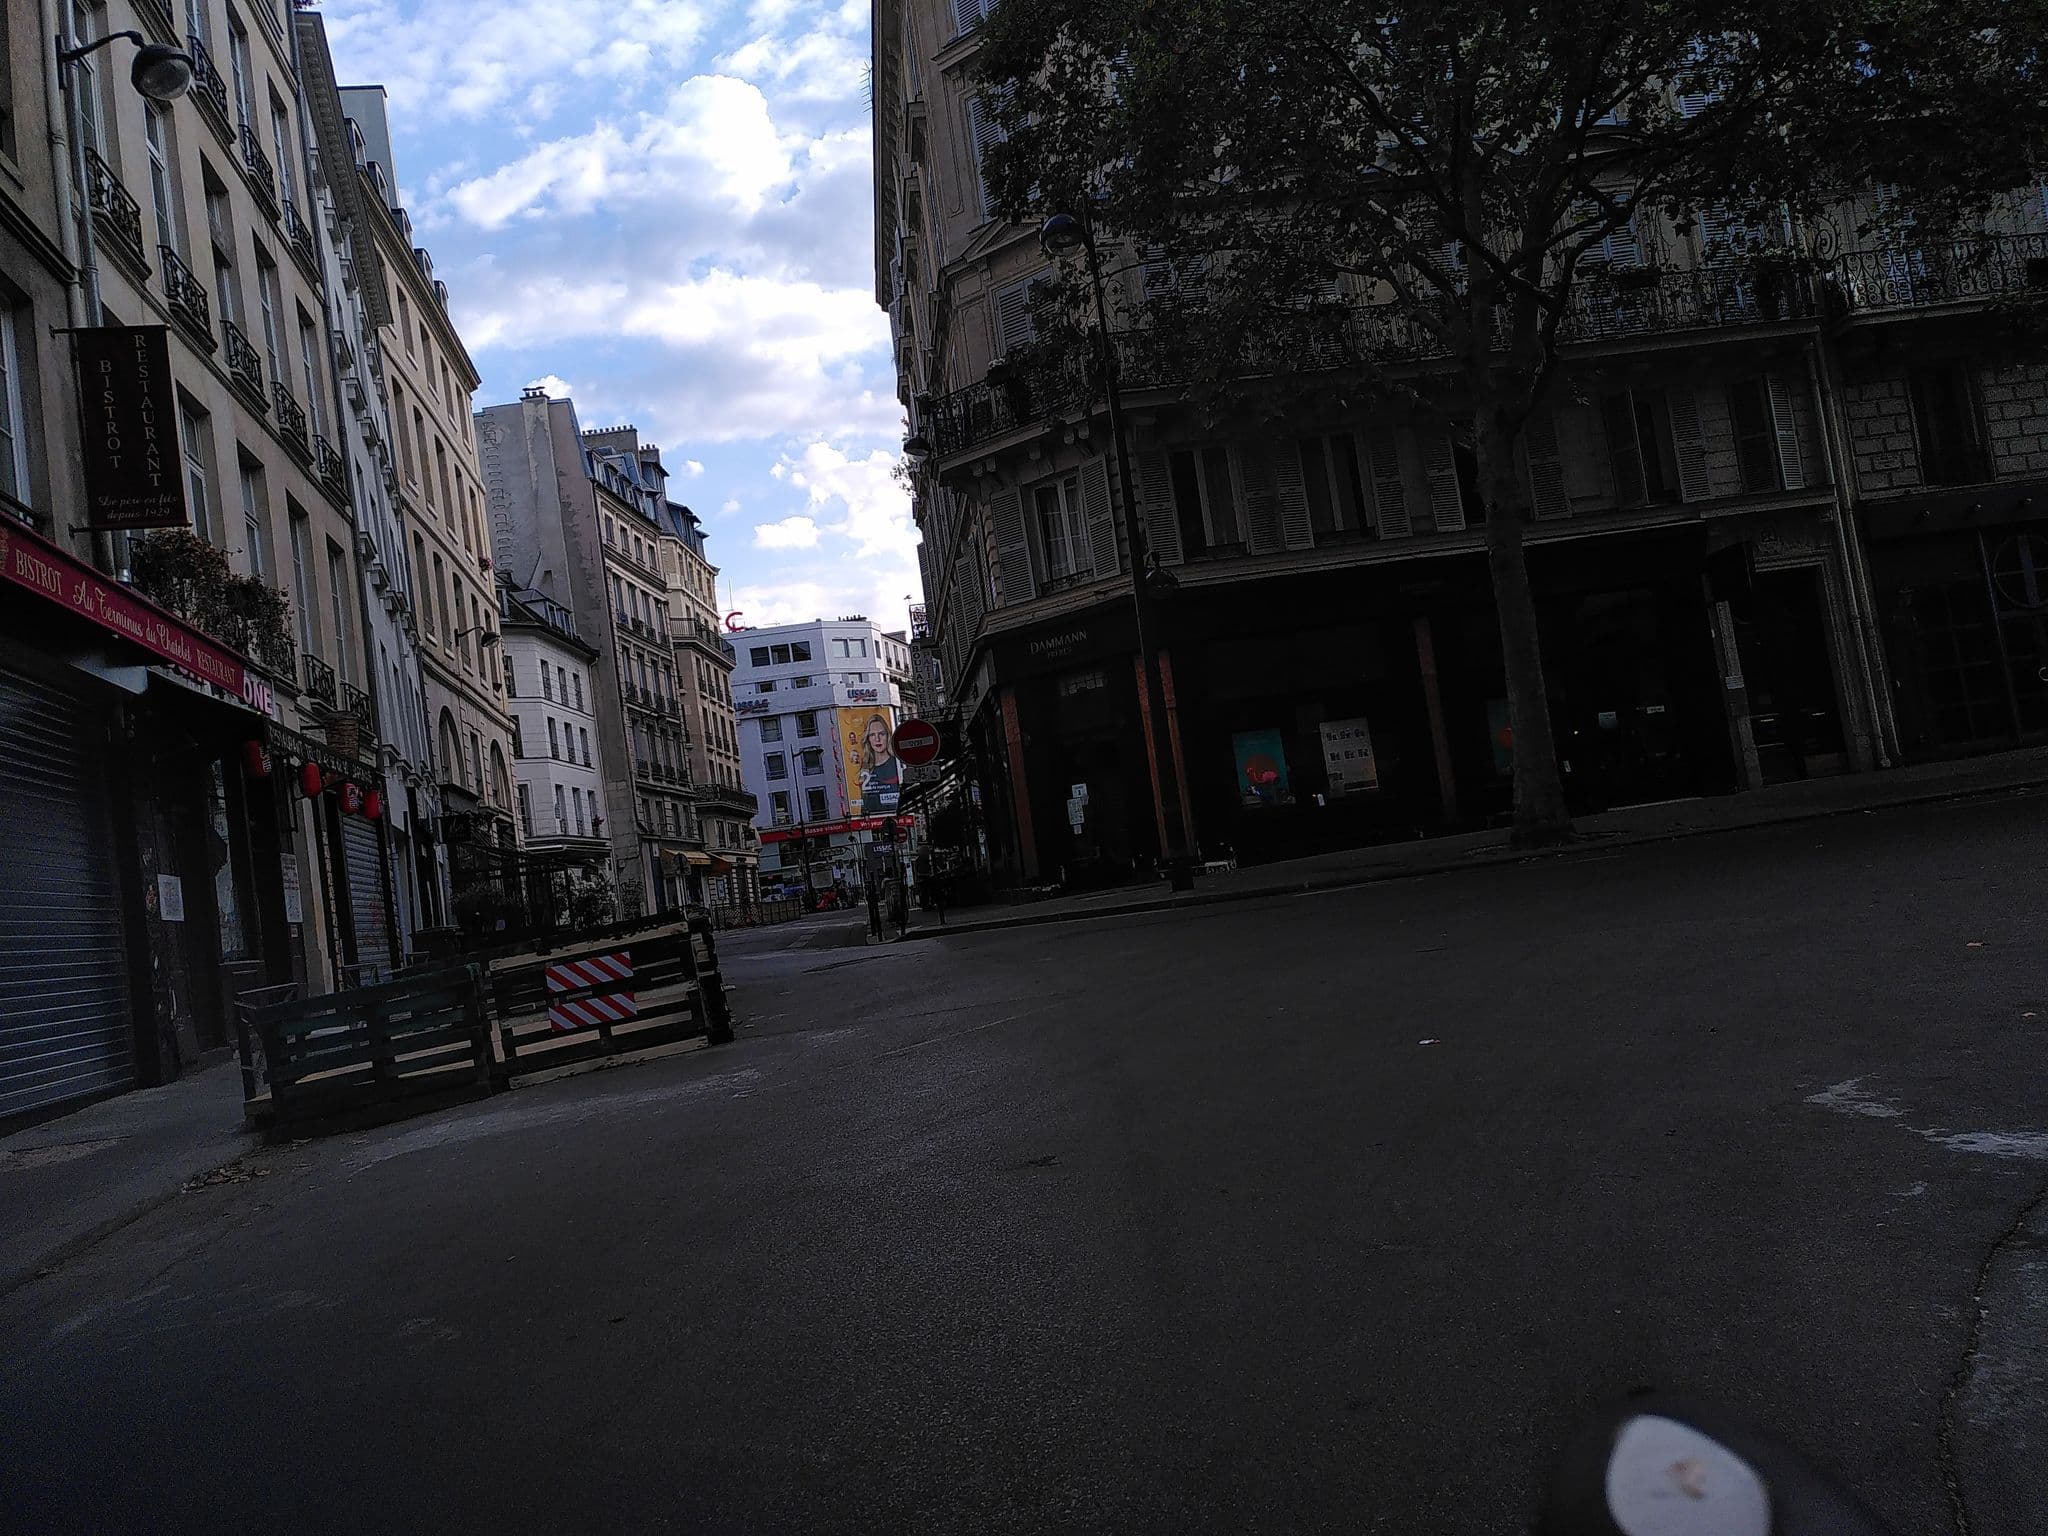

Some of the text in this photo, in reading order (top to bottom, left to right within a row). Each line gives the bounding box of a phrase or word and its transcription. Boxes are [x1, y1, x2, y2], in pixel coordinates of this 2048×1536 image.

[99, 359, 121, 469] BISTROT
[134, 334, 162, 487] RESTAURANT
[106, 507, 170, 520] depuis 1929
[16, 548, 62, 597] BISTROT
[73, 580, 94, 612] Au
[95, 587, 143, 638] Terminus
[146, 617, 157, 645] du
[196, 648, 237, 687] RESTAURANT
[1030, 630, 1087, 655] DAMMANN
[846, 688, 878, 699] LISSAC
